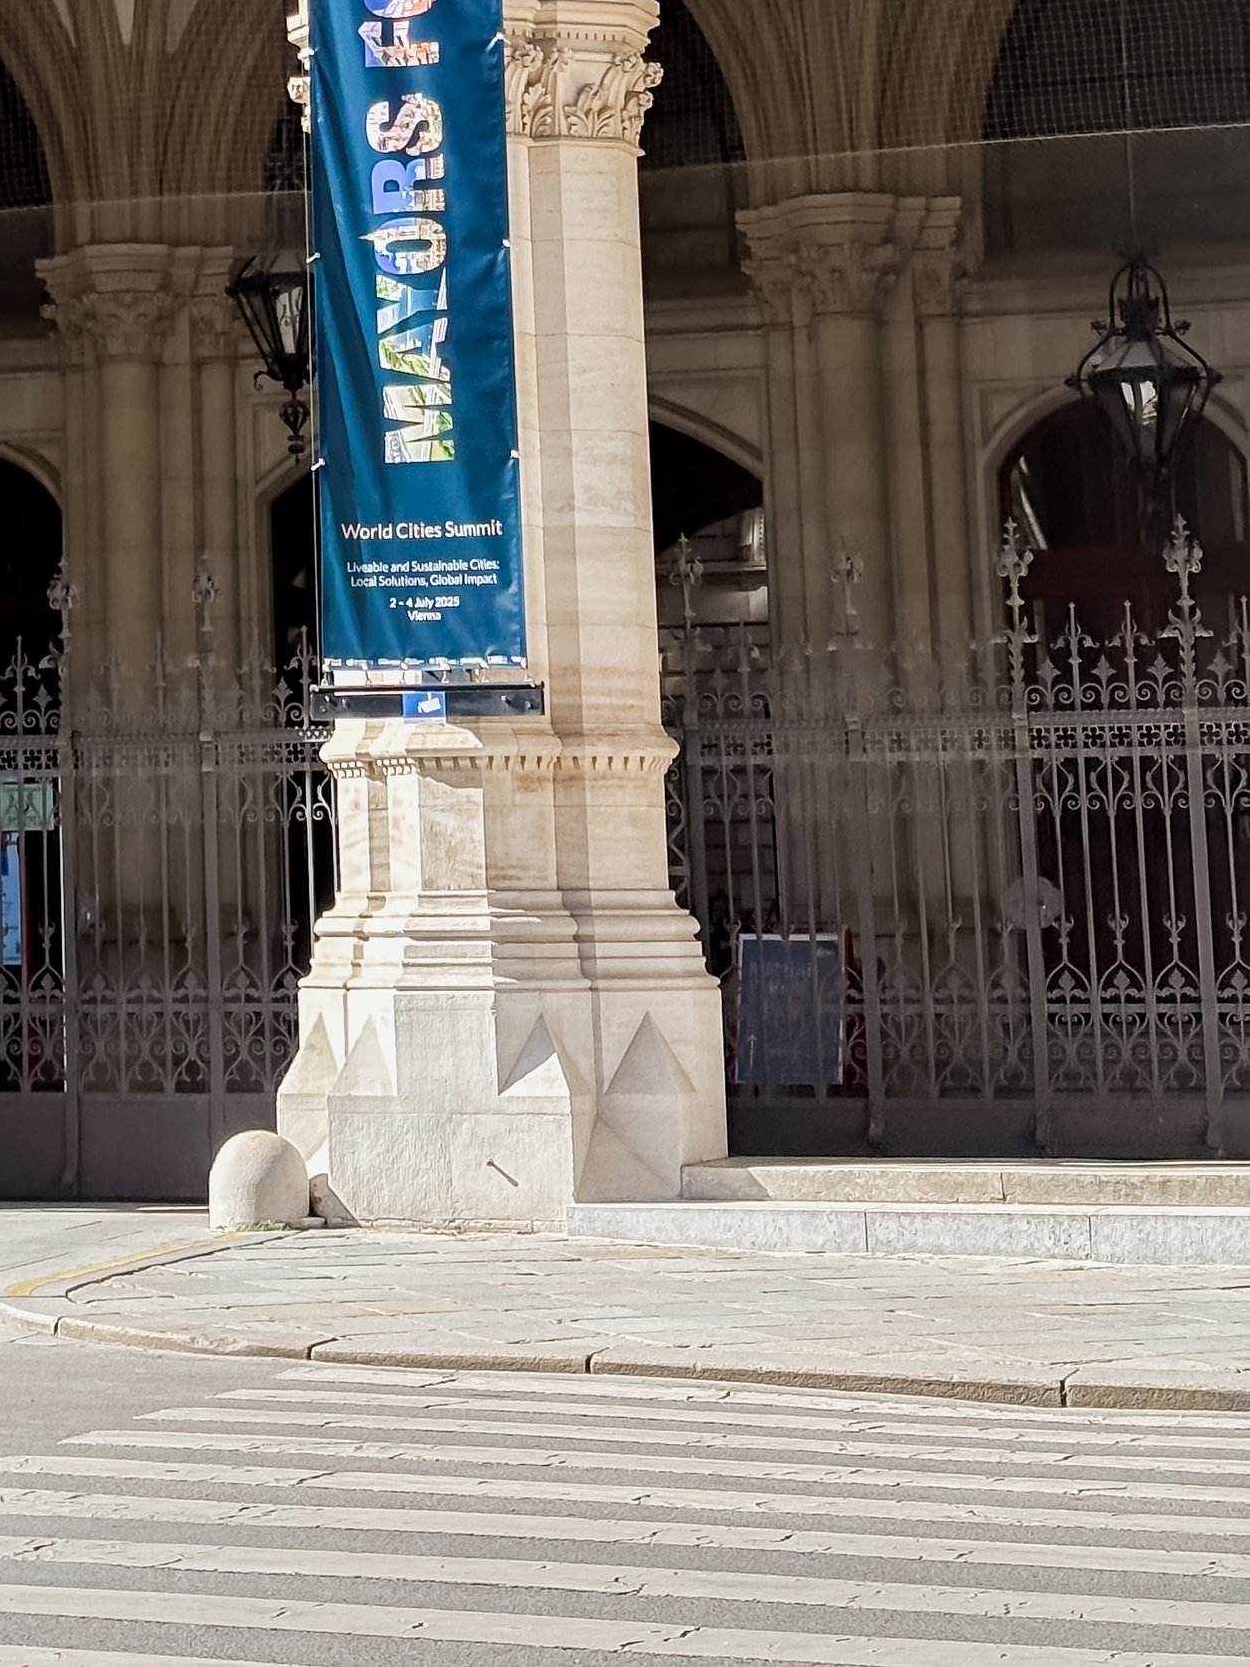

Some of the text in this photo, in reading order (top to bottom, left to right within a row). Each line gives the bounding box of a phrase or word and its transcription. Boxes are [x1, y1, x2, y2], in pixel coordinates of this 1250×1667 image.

[360, 92, 455, 464] MAYORS
[341, 519, 502, 540] World Cities Summit
[347, 558, 500, 573] Liveable and Sustainable Cities:
[350, 573, 498, 587] Local Solutions, Global Impact
[389, 597, 397, 608] 2
[406, 597, 413, 608] 4
[414, 596, 434, 610] July
[435, 596, 460, 608] 2025
[407, 610, 442, 621] Vienna
